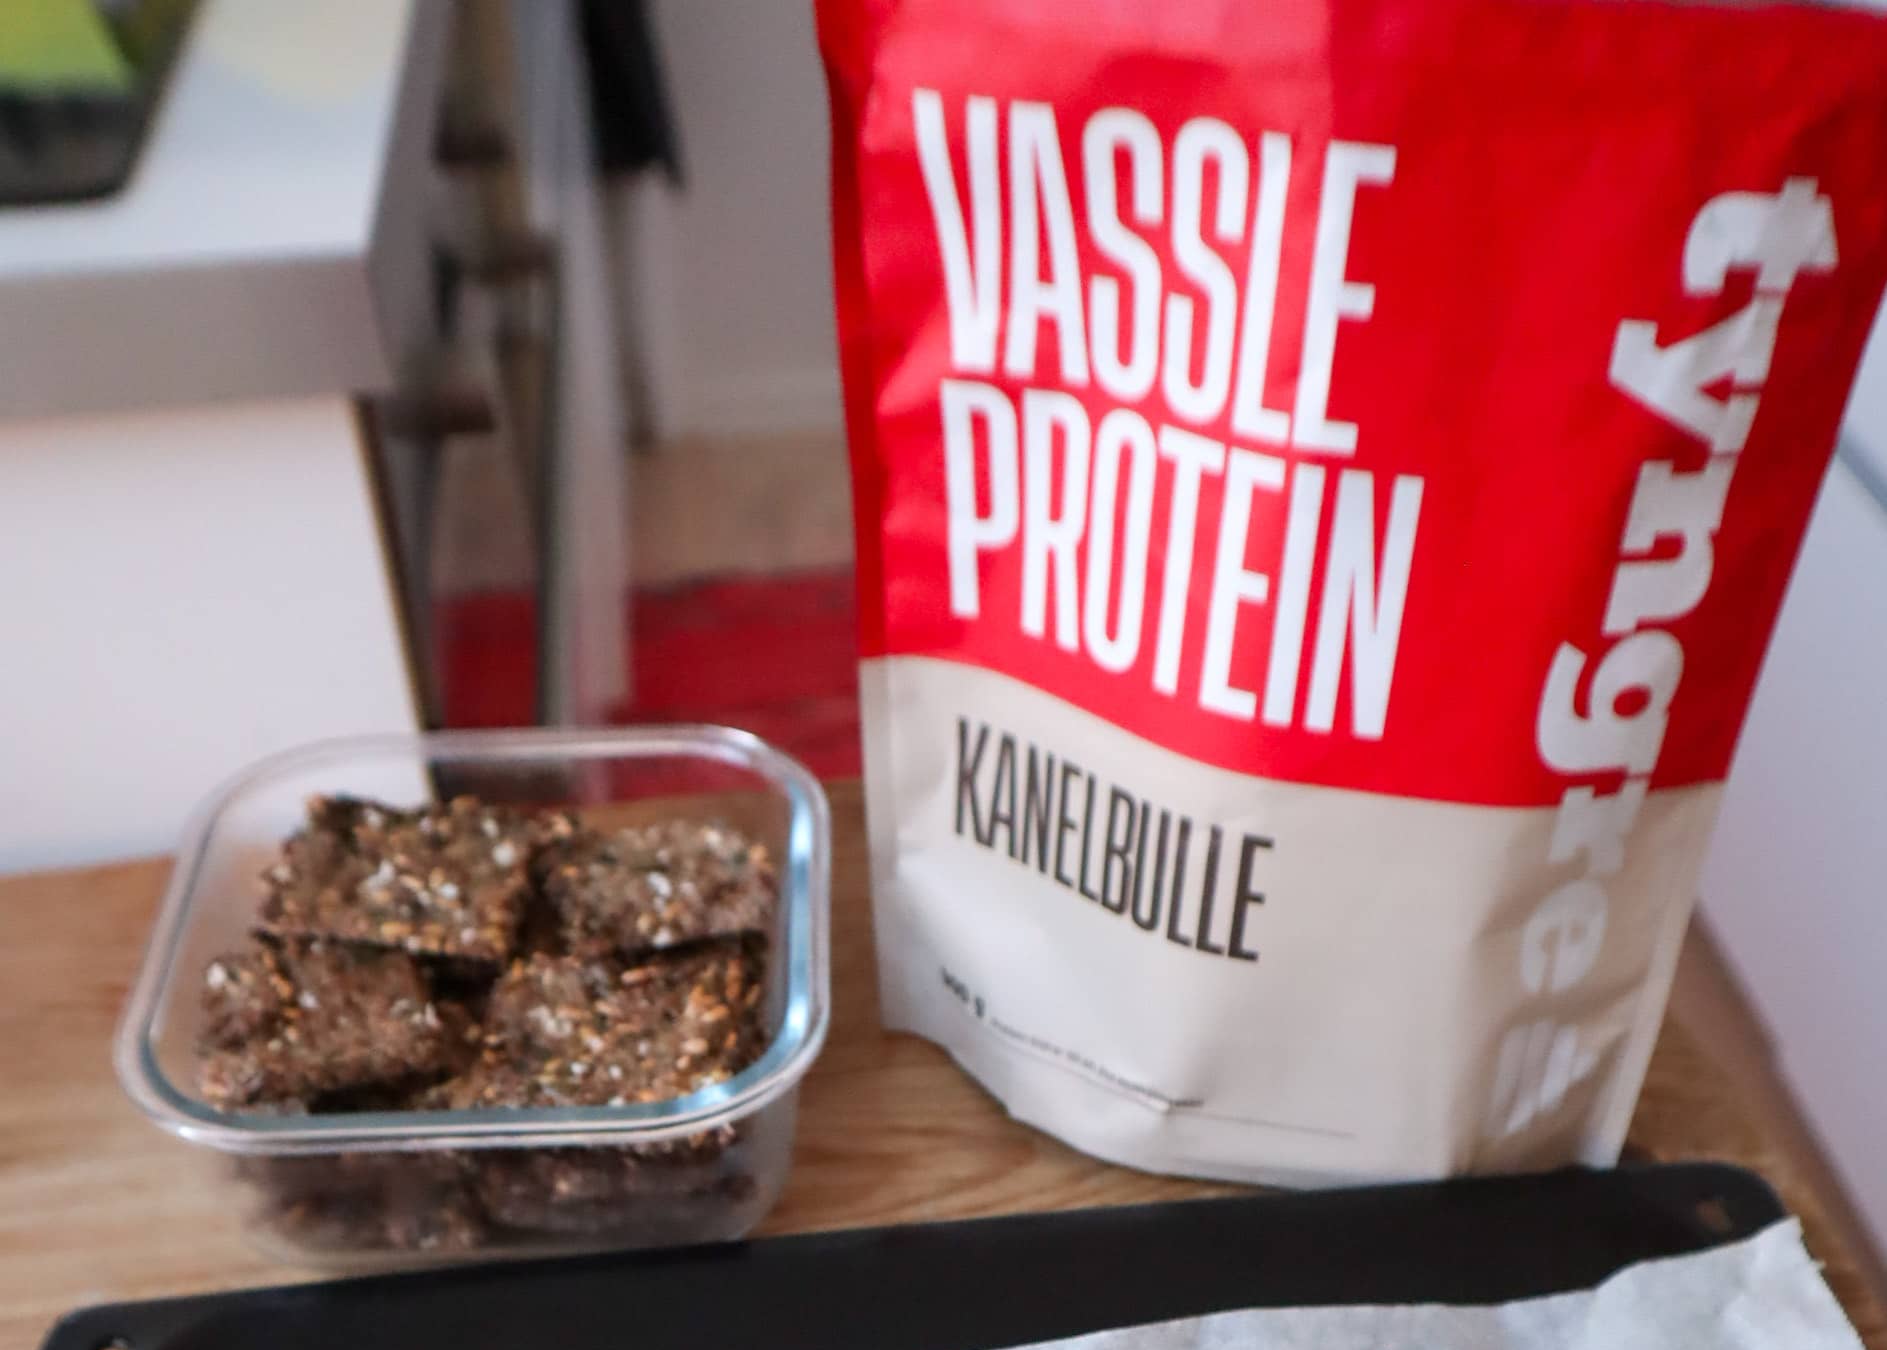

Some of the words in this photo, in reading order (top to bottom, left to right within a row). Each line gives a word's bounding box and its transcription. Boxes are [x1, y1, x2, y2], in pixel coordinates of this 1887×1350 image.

[912, 88, 1396, 456] VASSLE
[940, 381, 1424, 740] PROTEIN
[1519, 177, 1840, 994] tyngre
[955, 717, 1274, 962] KANELBULLE
